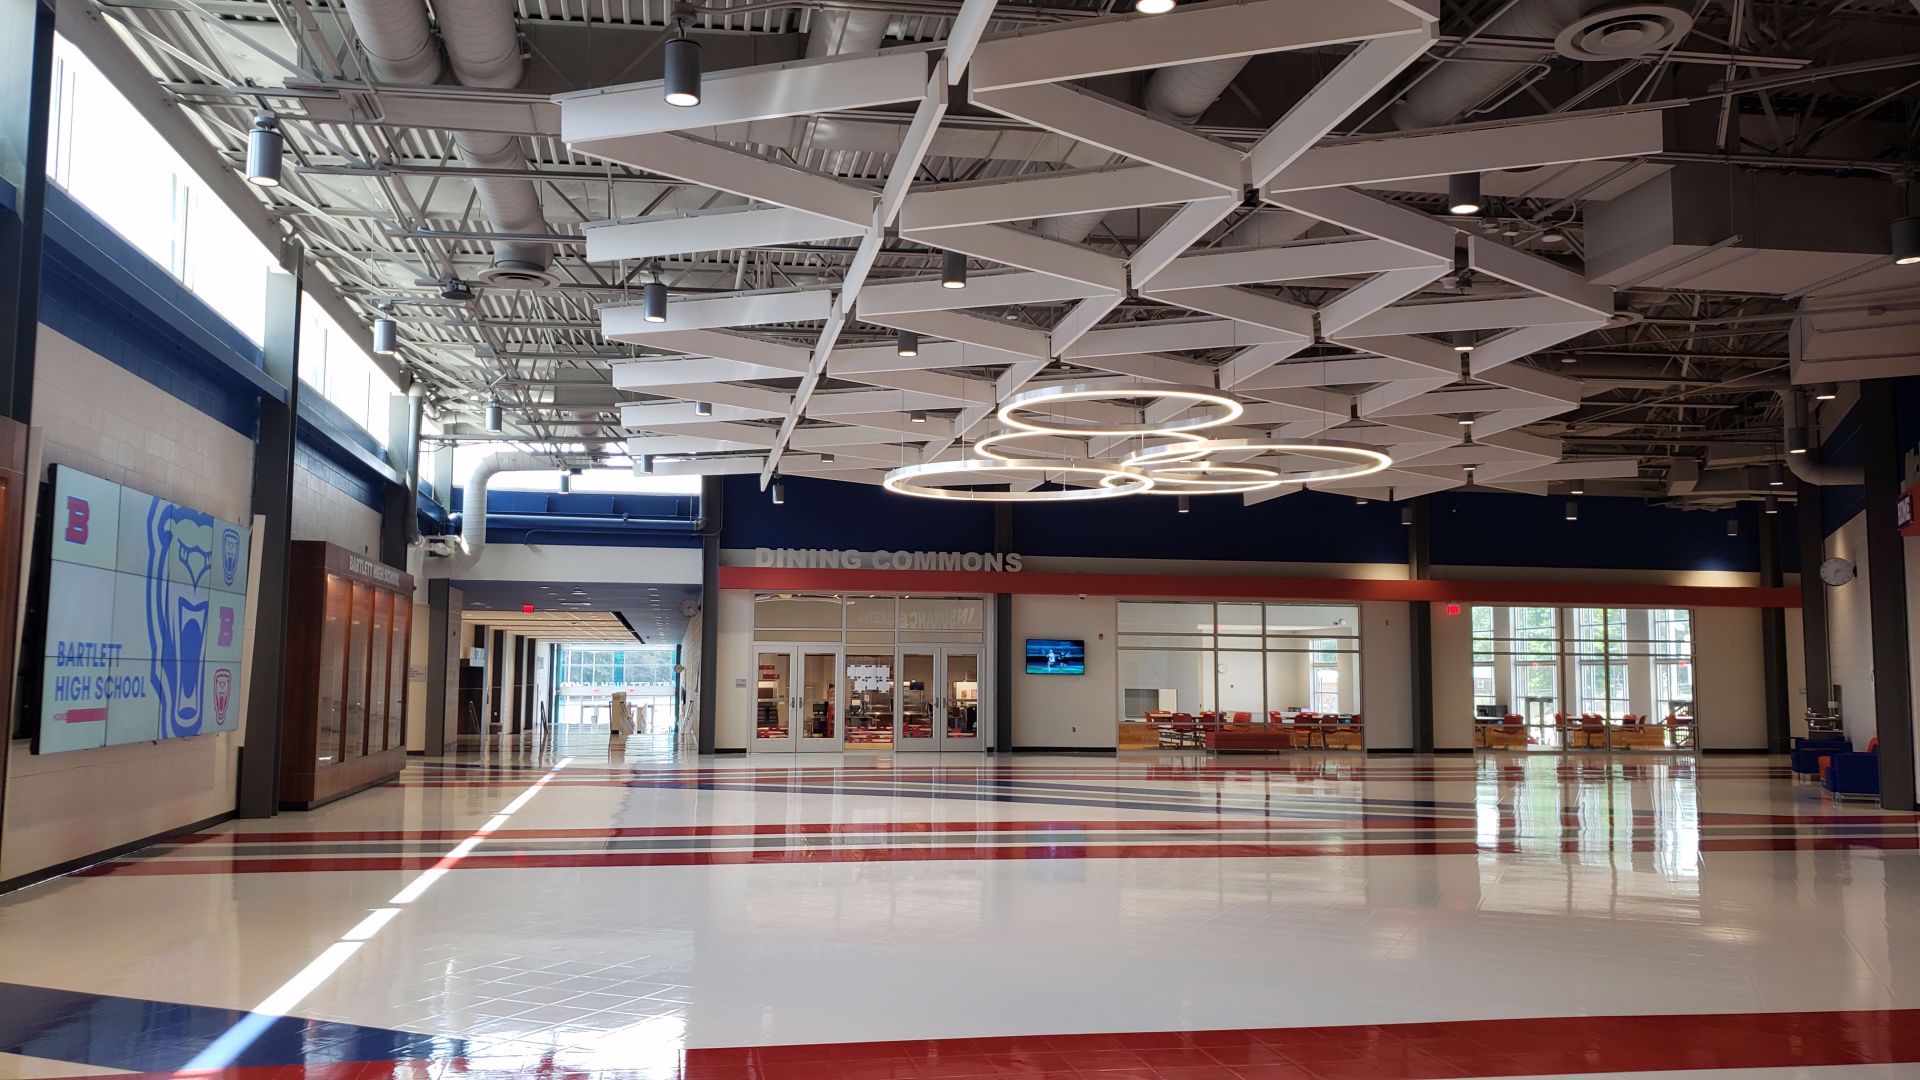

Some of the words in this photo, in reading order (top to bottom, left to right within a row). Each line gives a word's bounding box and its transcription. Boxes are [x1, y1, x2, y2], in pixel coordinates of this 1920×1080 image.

[65, 496, 90, 545] B
[755, 548, 862, 570] DINING
[872, 550, 1023, 573] COMMONS
[217, 606, 235, 647] B
[57, 641, 123, 667] BARTLETT
[55, 675, 91, 701] HIGH
[94, 675, 146, 700] SCHOOL
